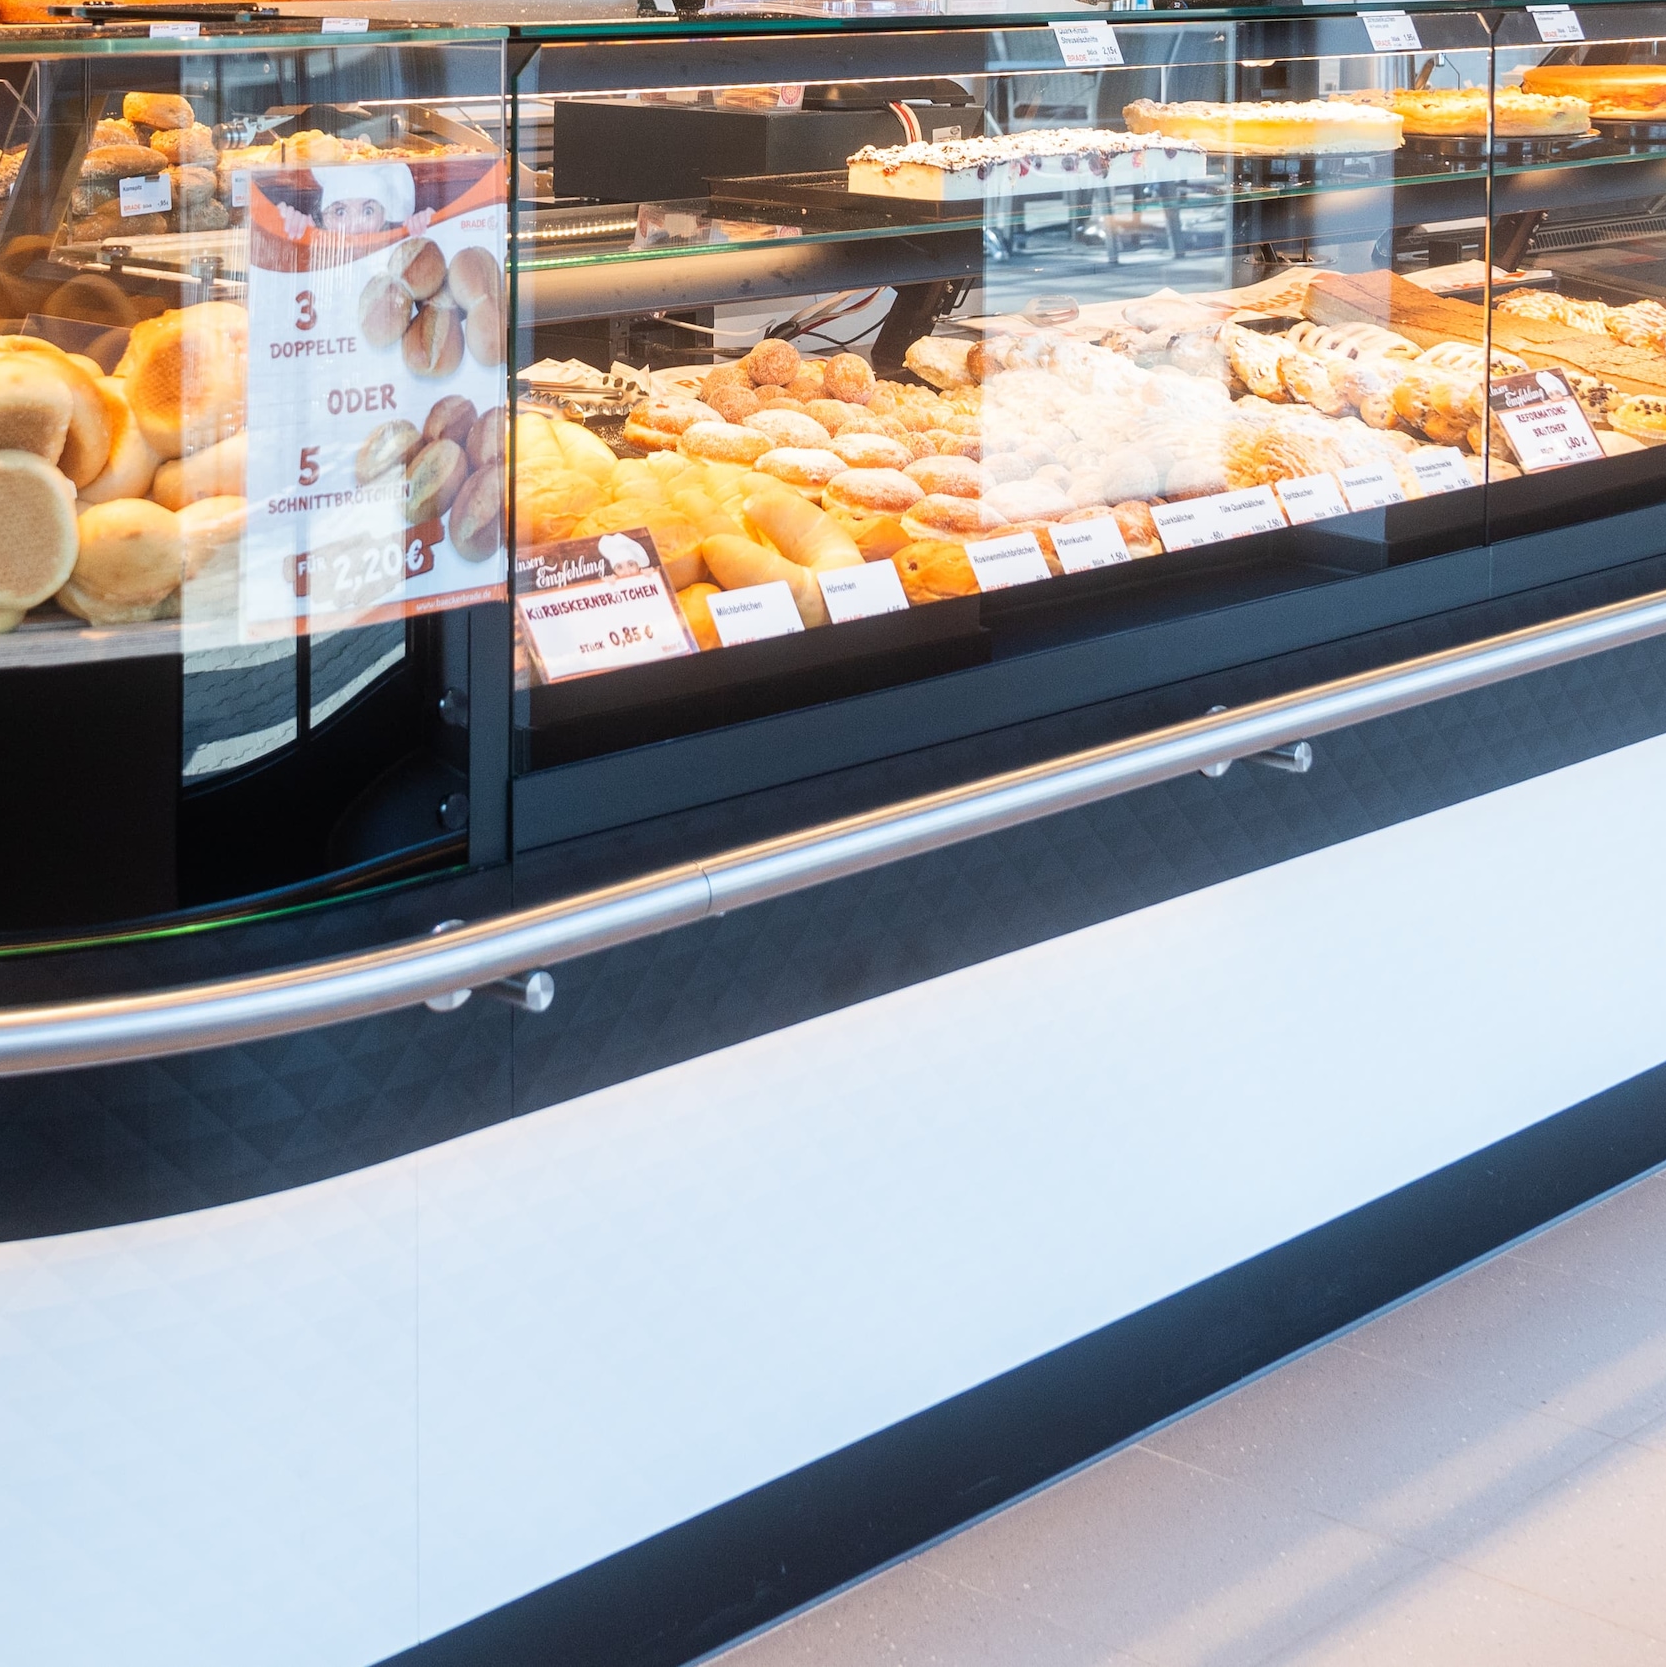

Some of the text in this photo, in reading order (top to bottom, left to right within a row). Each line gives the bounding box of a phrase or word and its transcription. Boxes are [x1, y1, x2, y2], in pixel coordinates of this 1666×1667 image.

[1067, 54, 1088, 62] BRADE
[123, 204, 141, 212] BRADE
[461, 219, 486, 229] BRADE
[295, 290, 318, 331] 3
[270, 336, 357, 359] DOPPELTE
[327, 383, 397, 416] ODER
[298, 445, 321, 487] 5
[268, 483, 410, 515] SCHNITTBRÖTCHEN
[1283, 488, 1314, 501] Spritzkuchen
[1231, 498, 1266, 512] Quarkbällchen
[1158, 513, 1195, 526] Quarkbällchen
[1056, 534, 1093, 547] Pfannkuchen
[973, 545, 1036, 564] Rosinenmilchbrötchen
[297, 538, 425, 592] FÜR 2,20 €
[536, 555, 606, 589] Empfehlung
[826, 581, 857, 594] Hörnchen
[416, 589, 492, 611] www.baeckerbrade.de
[716, 600, 763, 616] Milchbrötchen
[609, 627, 642, 648] 0,85
